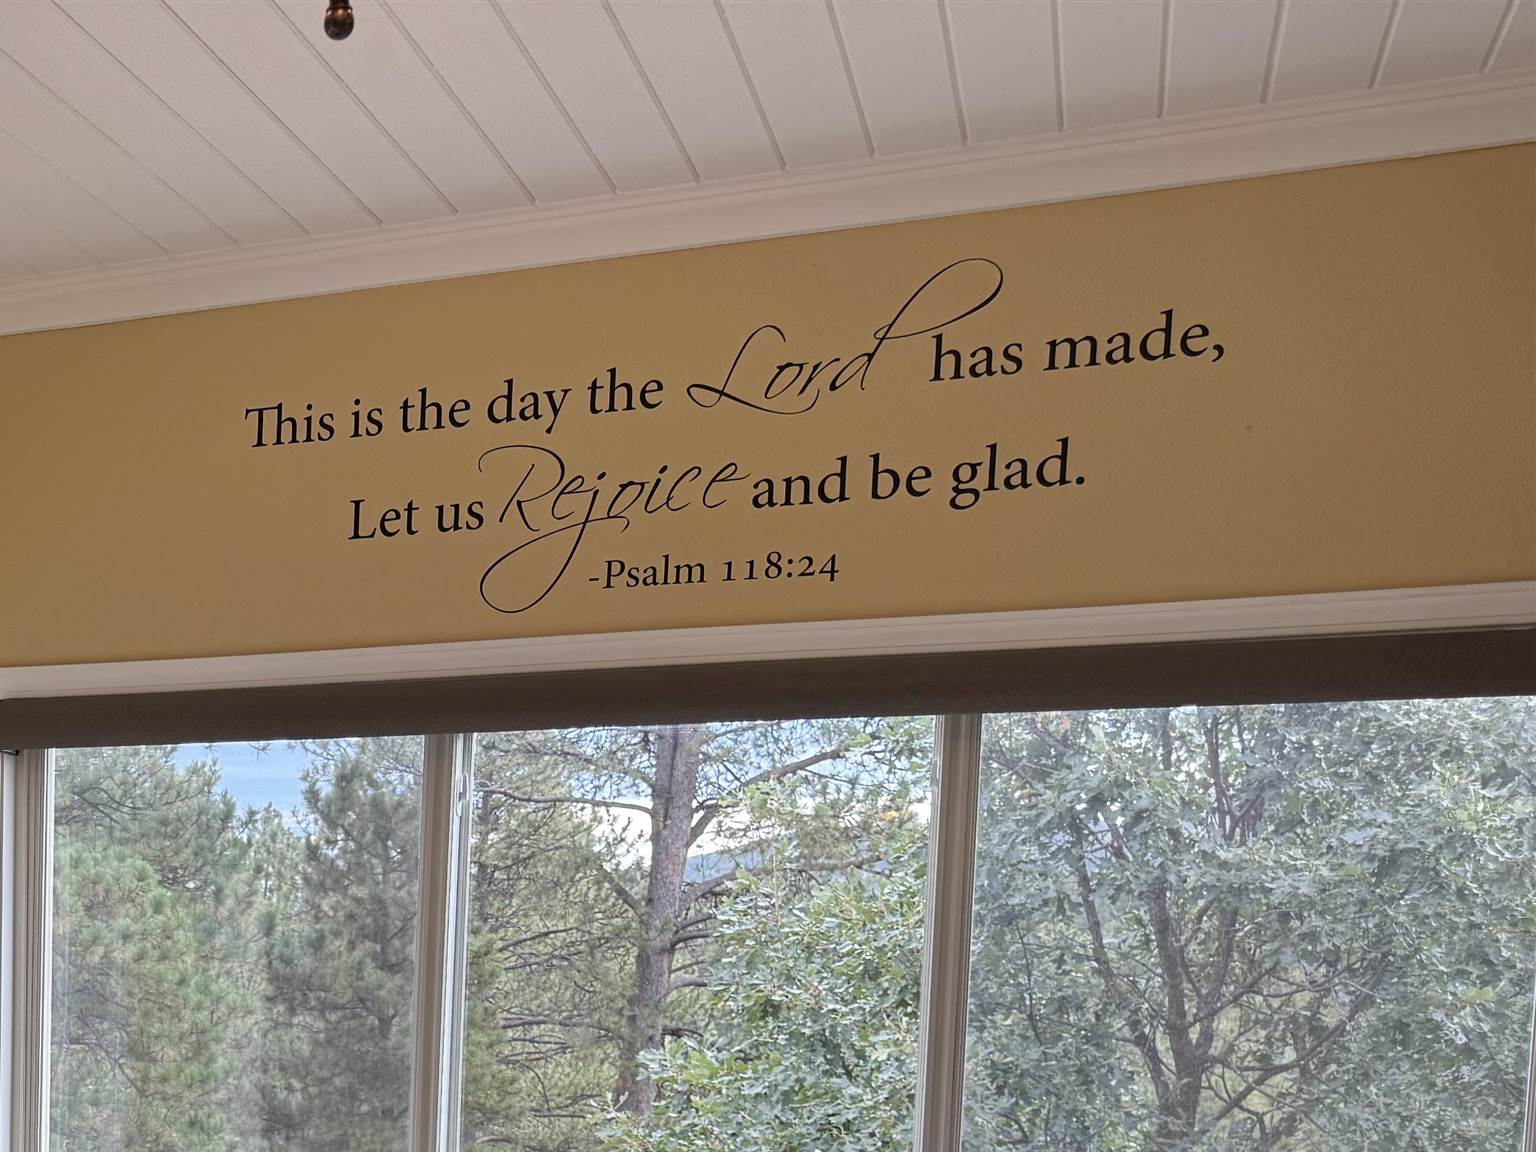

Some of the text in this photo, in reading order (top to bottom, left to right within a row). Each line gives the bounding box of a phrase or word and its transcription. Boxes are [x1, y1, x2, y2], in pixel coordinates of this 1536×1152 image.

[244, 257, 1225, 448] This is the day the Lord has made,
[348, 436, 1085, 614] Let us Rejoice and be glad.
[588, 553, 840, 589] -Psalm 118:24
